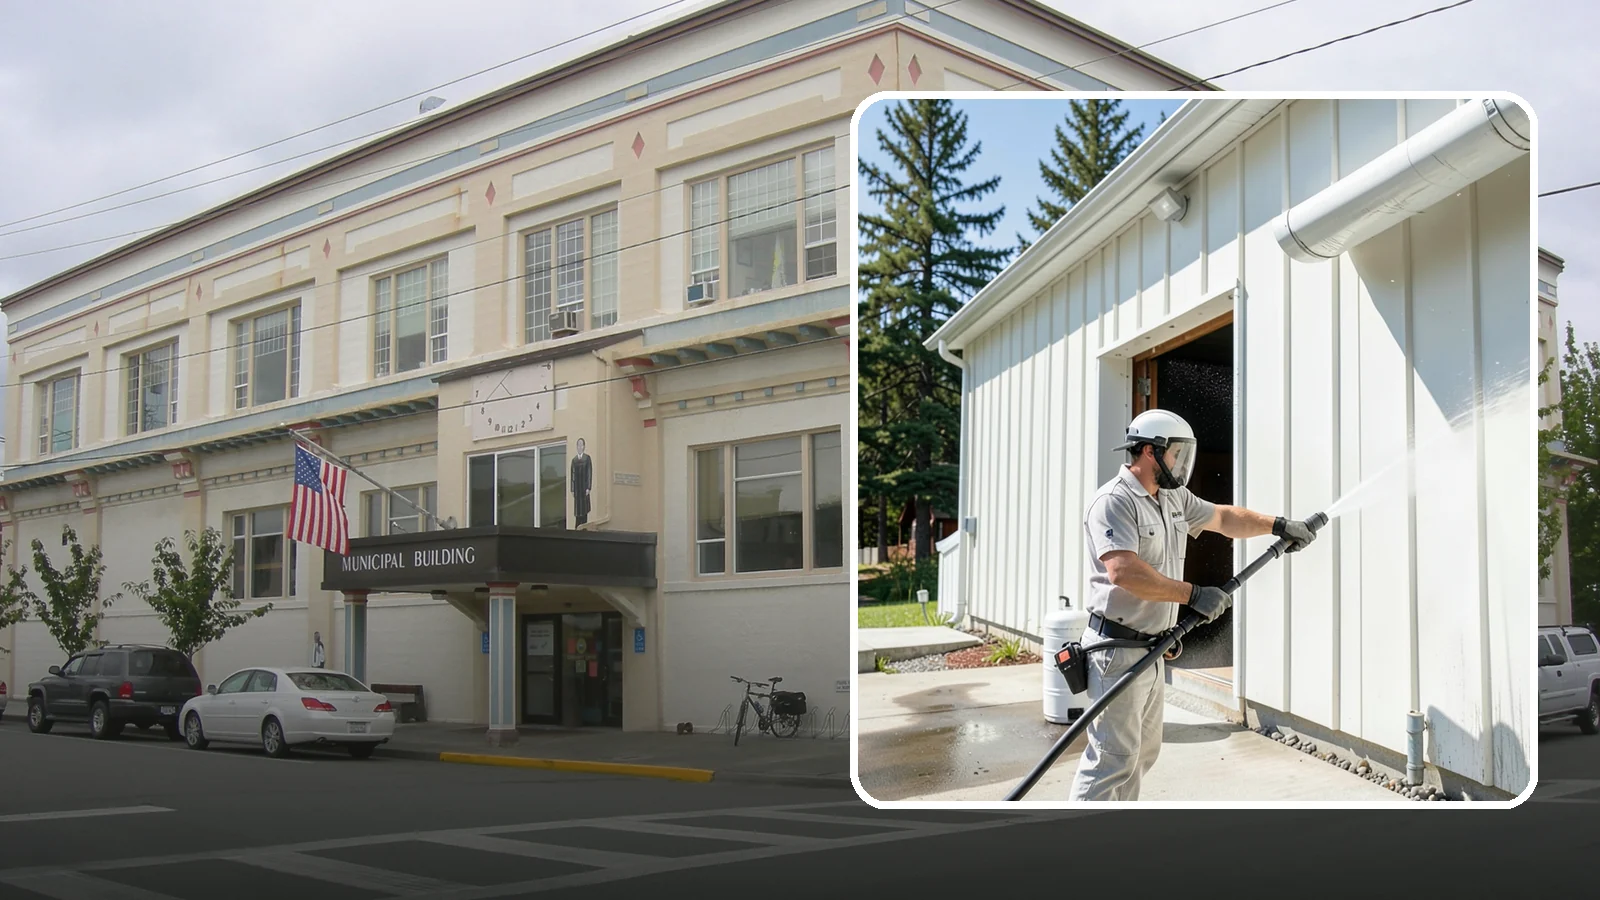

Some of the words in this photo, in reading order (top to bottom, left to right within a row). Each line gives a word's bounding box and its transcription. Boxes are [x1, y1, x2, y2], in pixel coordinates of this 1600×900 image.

[488, 418, 492, 426] 9
[521, 420, 526, 428] 2
[494, 424, 500, 432] 10
[342, 552, 405, 572] MUNICIPAL
[414, 546, 475, 567] BUILDING
